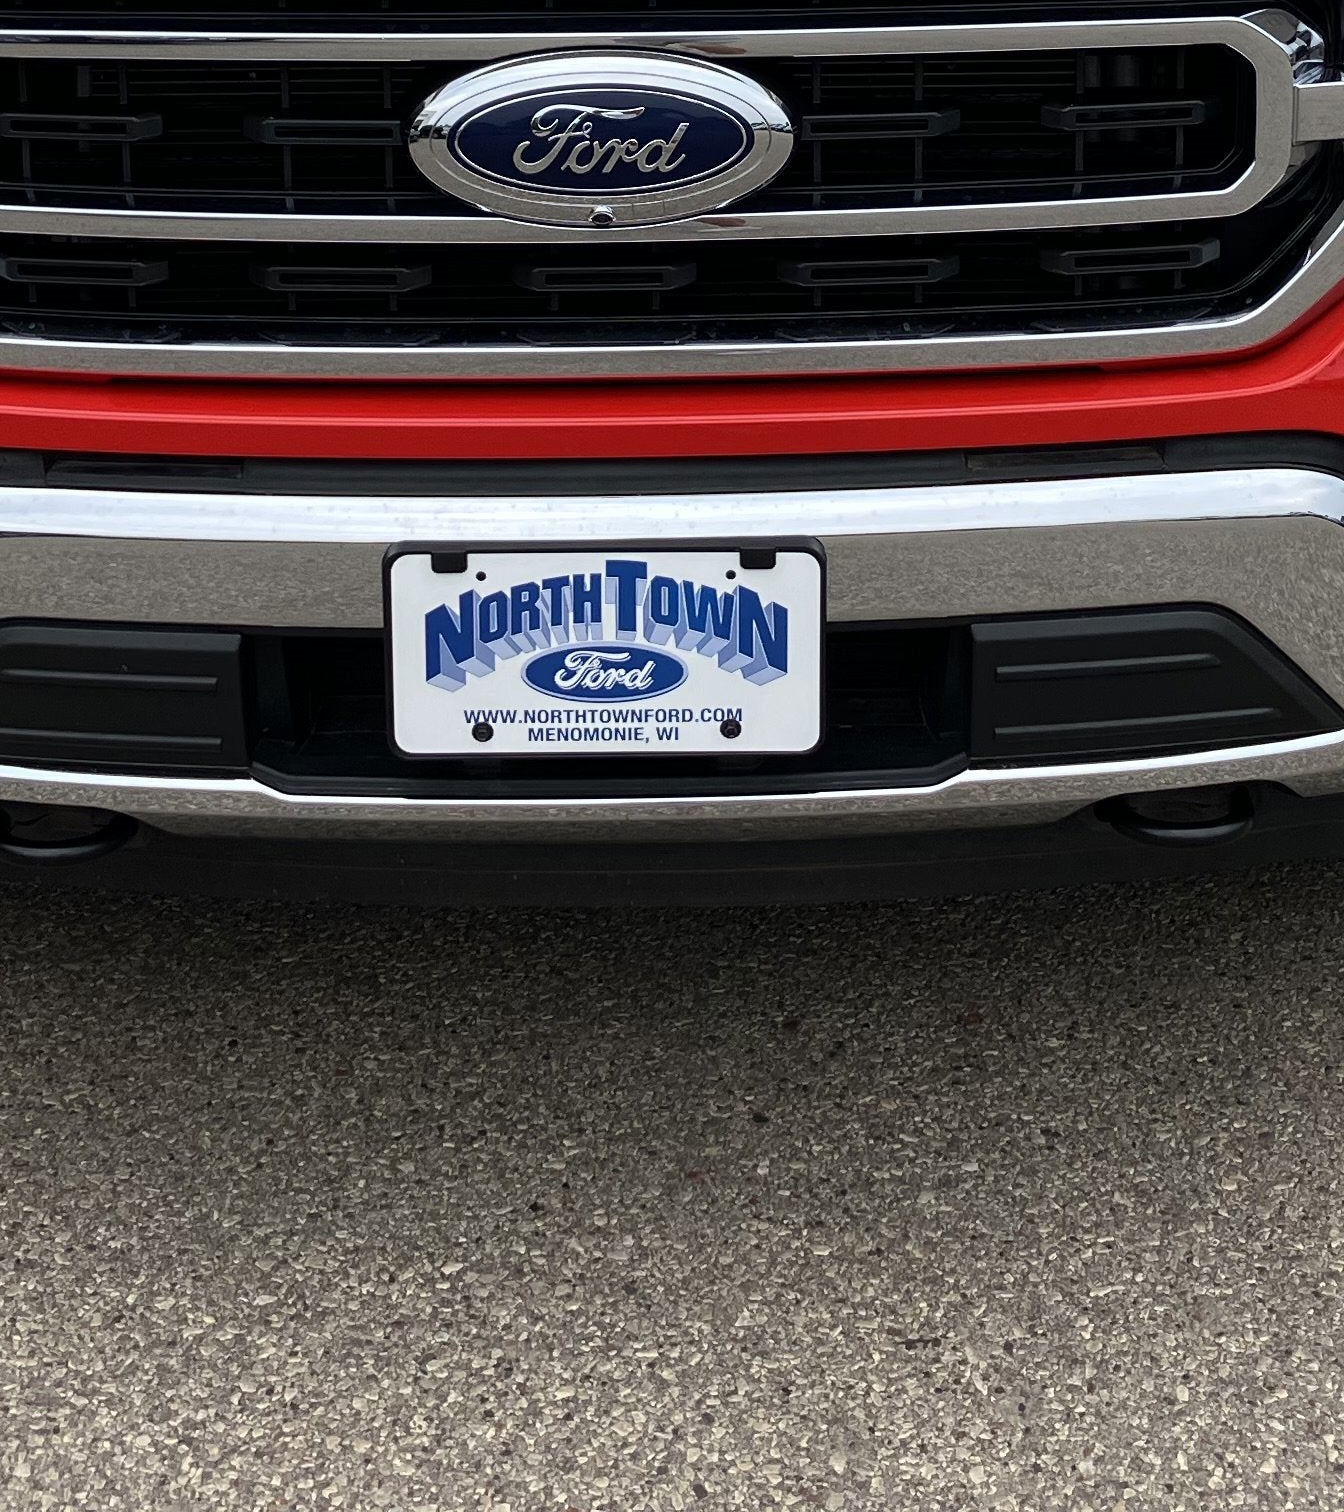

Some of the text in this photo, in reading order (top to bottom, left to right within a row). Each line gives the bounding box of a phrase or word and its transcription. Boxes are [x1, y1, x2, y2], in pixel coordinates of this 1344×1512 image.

[512, 103, 689, 175] Ford
[555, 650, 656, 690] Ford
[463, 707, 743, 724] WWW.NORTHTOWNFORD.COM
[528, 726, 679, 743] MENOMONIE, WI
